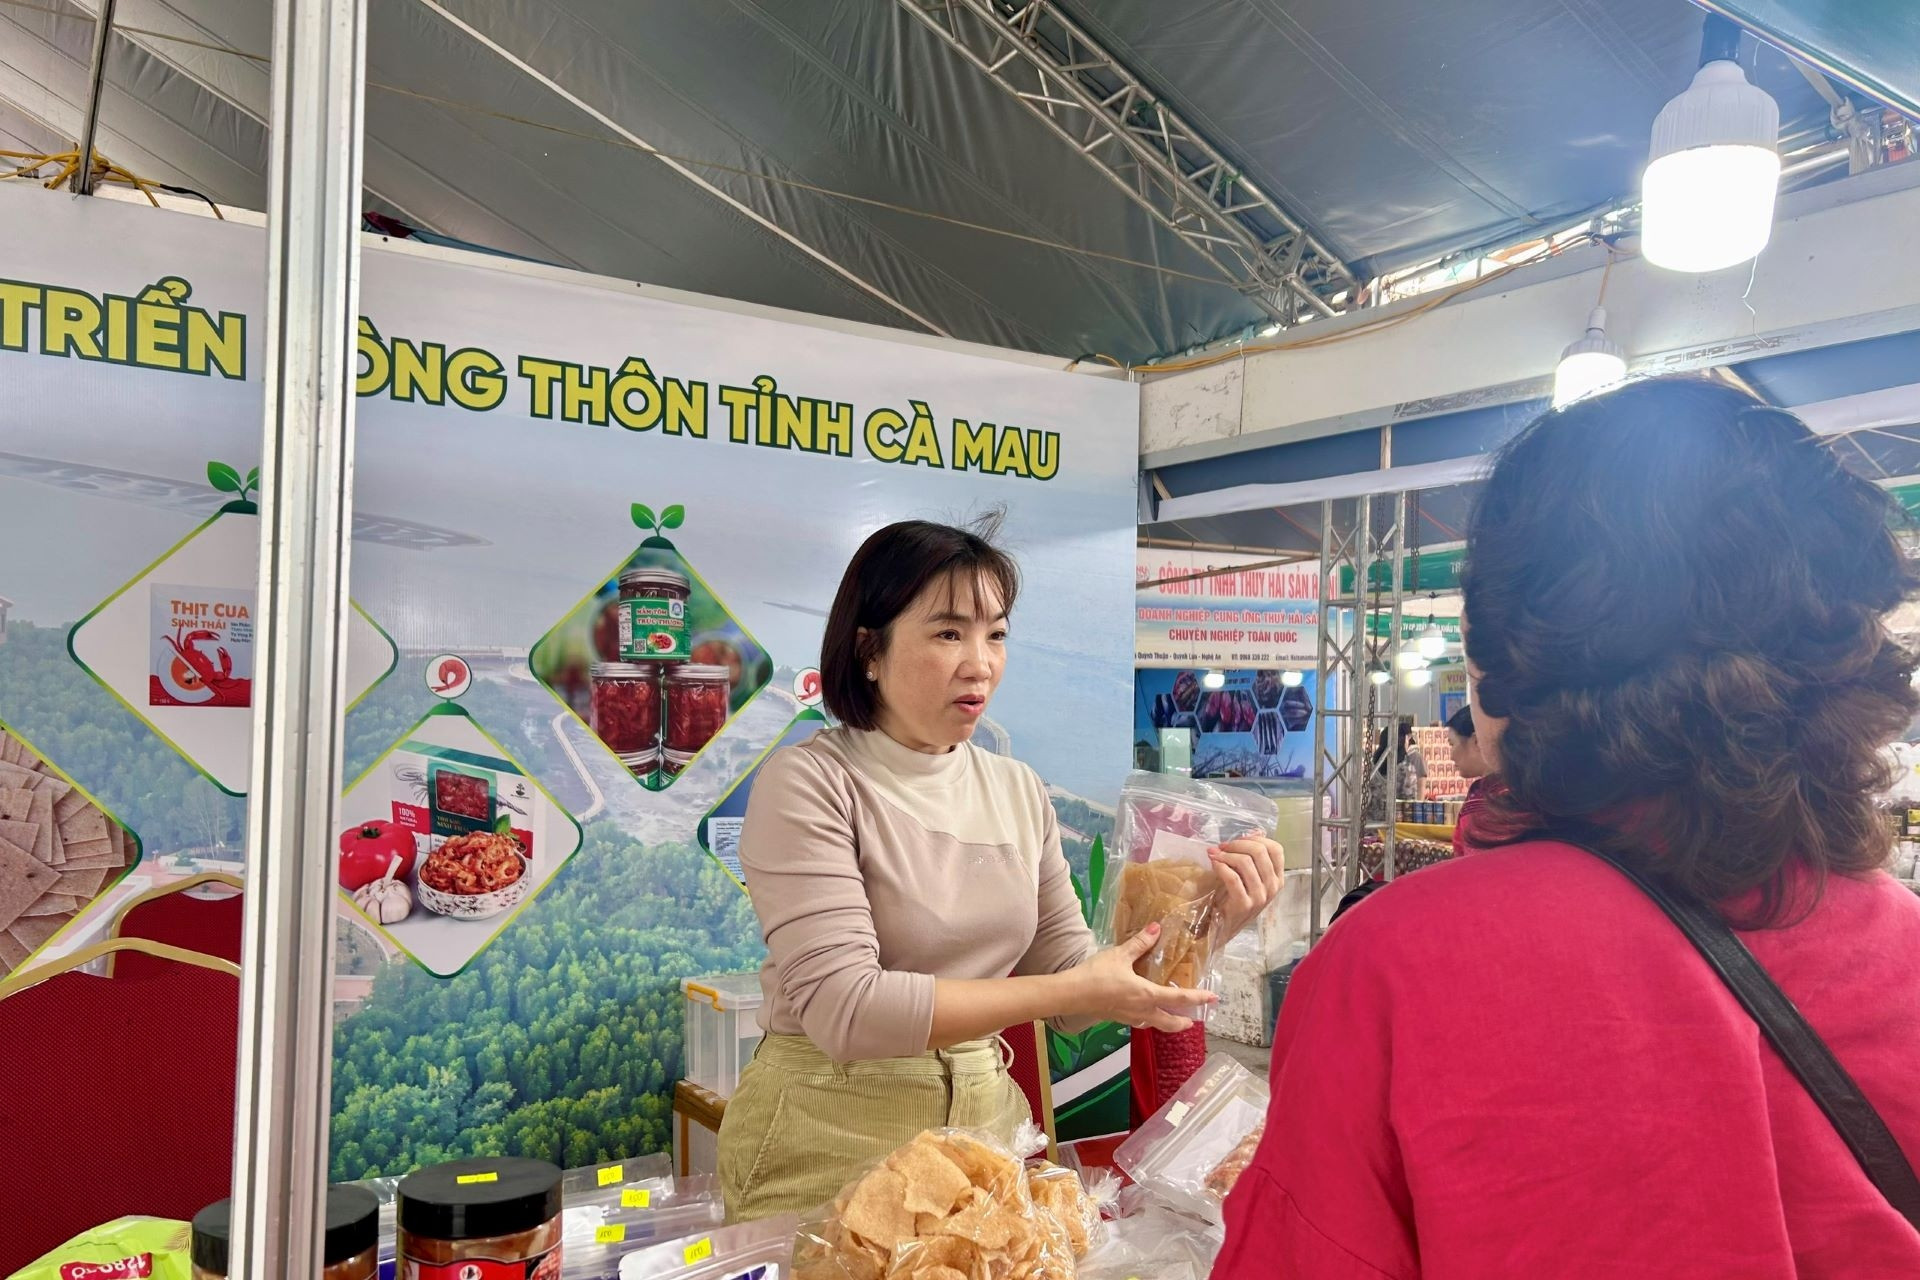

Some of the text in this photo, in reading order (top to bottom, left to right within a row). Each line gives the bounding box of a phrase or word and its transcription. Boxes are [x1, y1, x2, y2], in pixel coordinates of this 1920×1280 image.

[0, 276, 1060, 481] TRIỂN ÔNG THÔN TỈNH CÀ MAU
[171, 600, 250, 619] THỊT CUA
[1138, 608, 1172, 621] DOANH
[1213, 610, 1239, 623] CUNG
[1305, 609, 1319, 626] SẢ
[171, 618, 198, 629] SINH
[201, 620, 227, 630] THÁI
[1169, 627, 1207, 641] CHUYÊN
[1210, 628, 1244, 645] NGHIỆP
[399, 807, 416, 818] 100%
